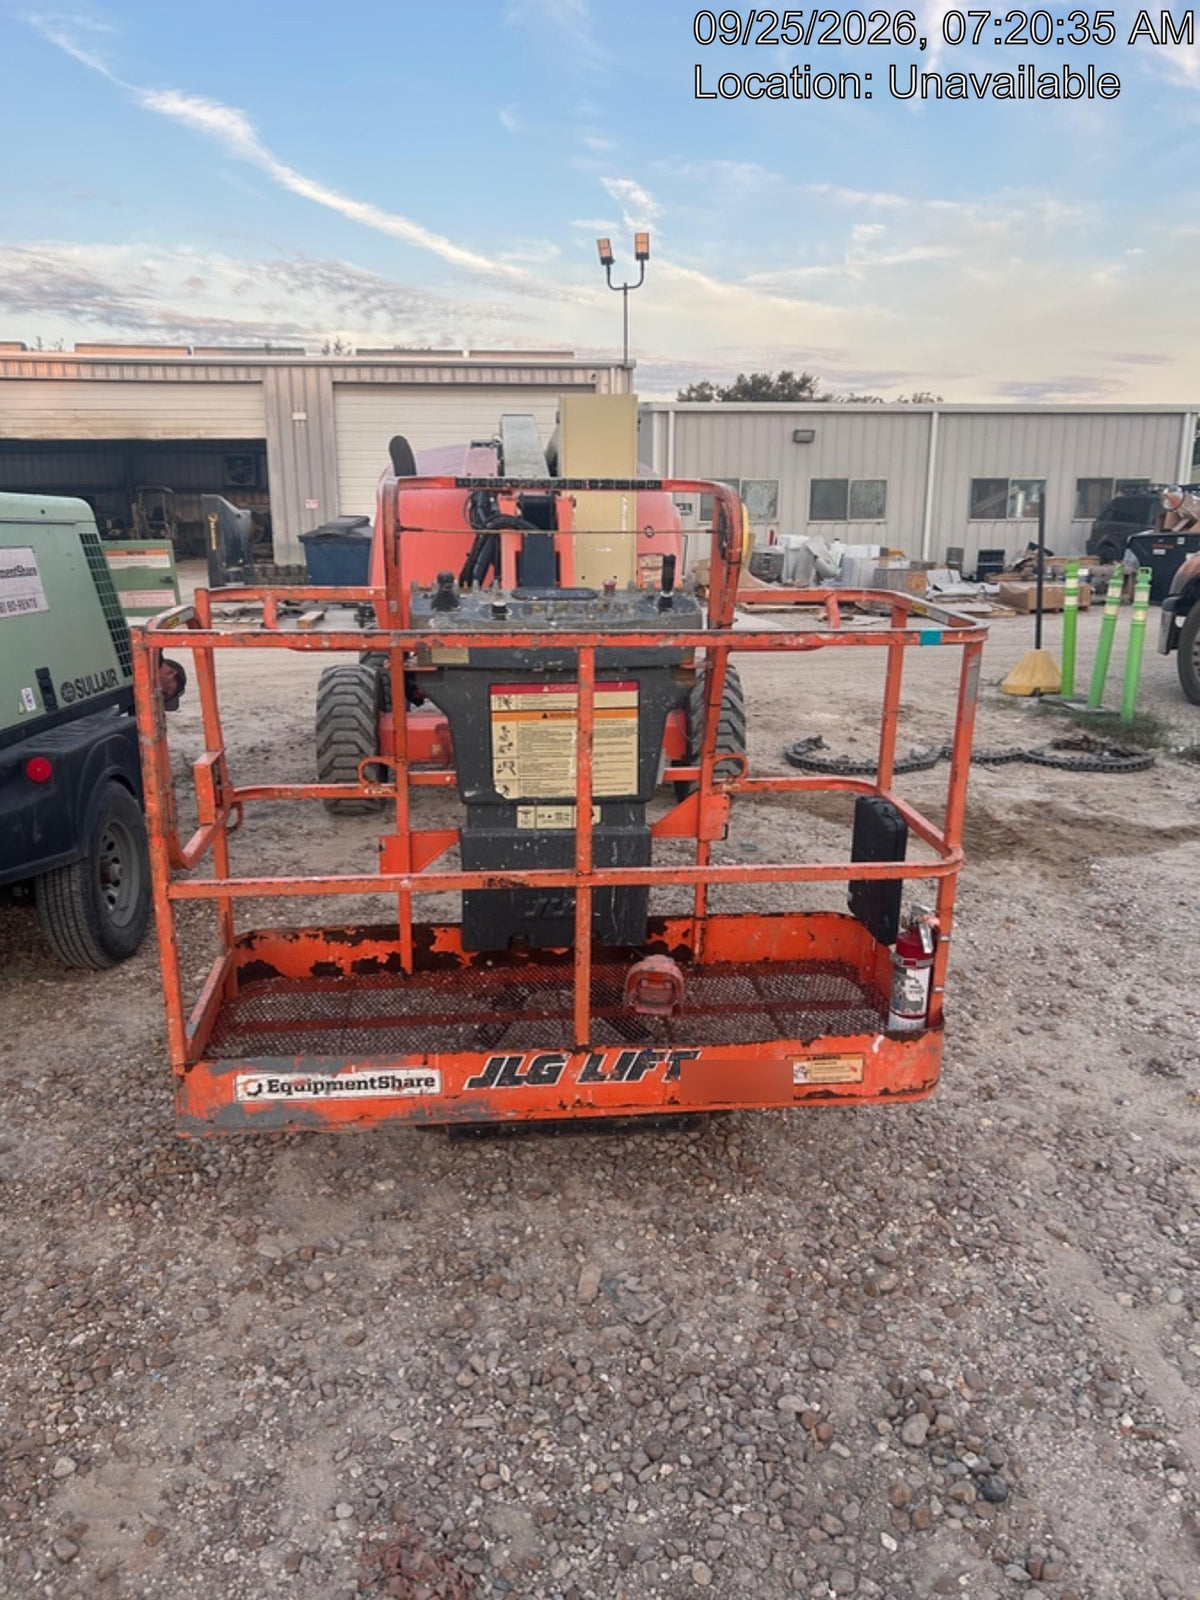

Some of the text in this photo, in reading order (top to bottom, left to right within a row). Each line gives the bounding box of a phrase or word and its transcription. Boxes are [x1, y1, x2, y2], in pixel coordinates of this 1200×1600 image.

[75, 668, 119, 699] SULLAIR
[463, 1049, 702, 1090] JLG LIFT
[267, 1075, 436, 1096] EquipmentShare
